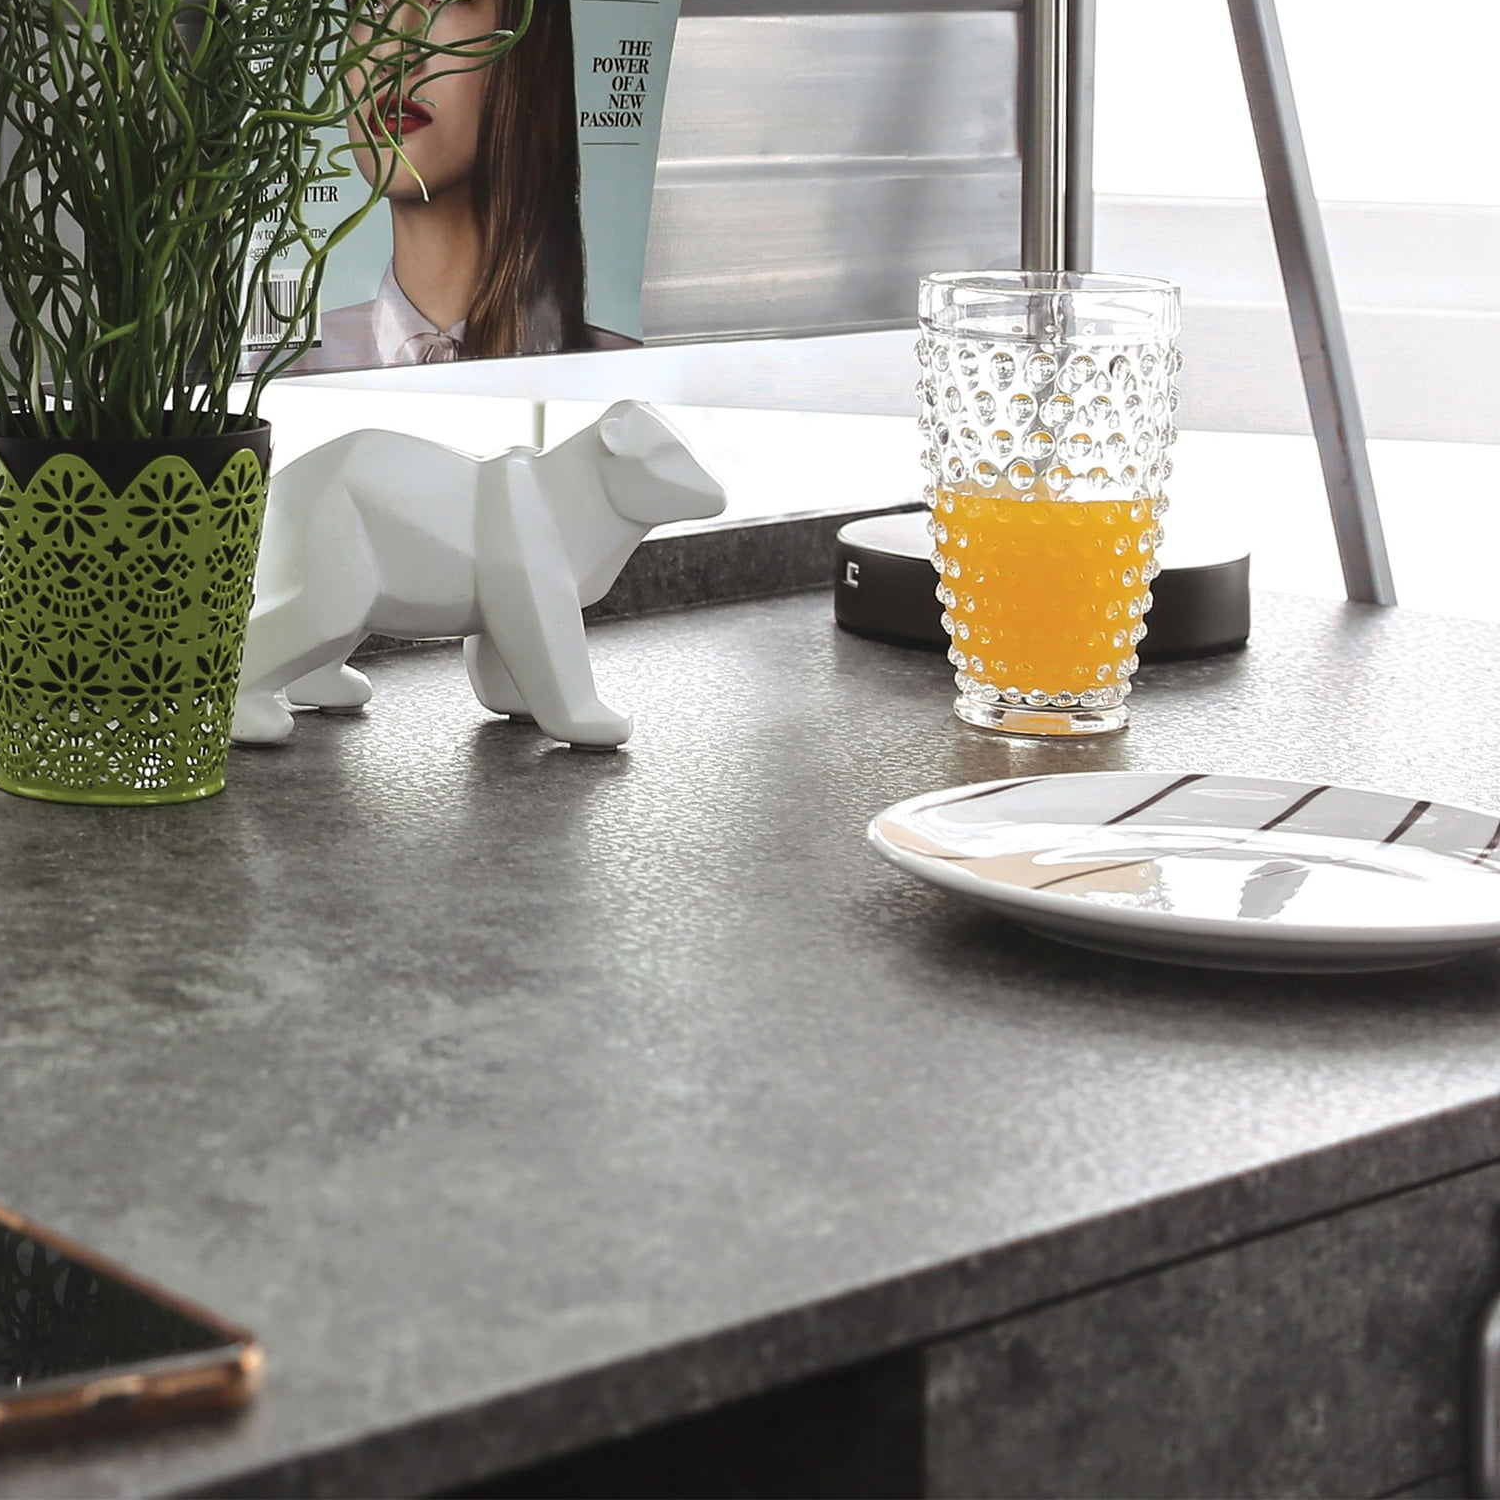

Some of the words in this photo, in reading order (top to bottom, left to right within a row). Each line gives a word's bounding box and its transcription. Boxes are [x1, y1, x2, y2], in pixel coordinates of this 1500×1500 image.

[619, 40, 652, 56] THE
[592, 57, 649, 74] POWER
[612, 76, 634, 92] OF
[635, 77, 646, 92] A
[608, 94, 646, 109] NEW
[580, 111, 643, 128] PASSION
